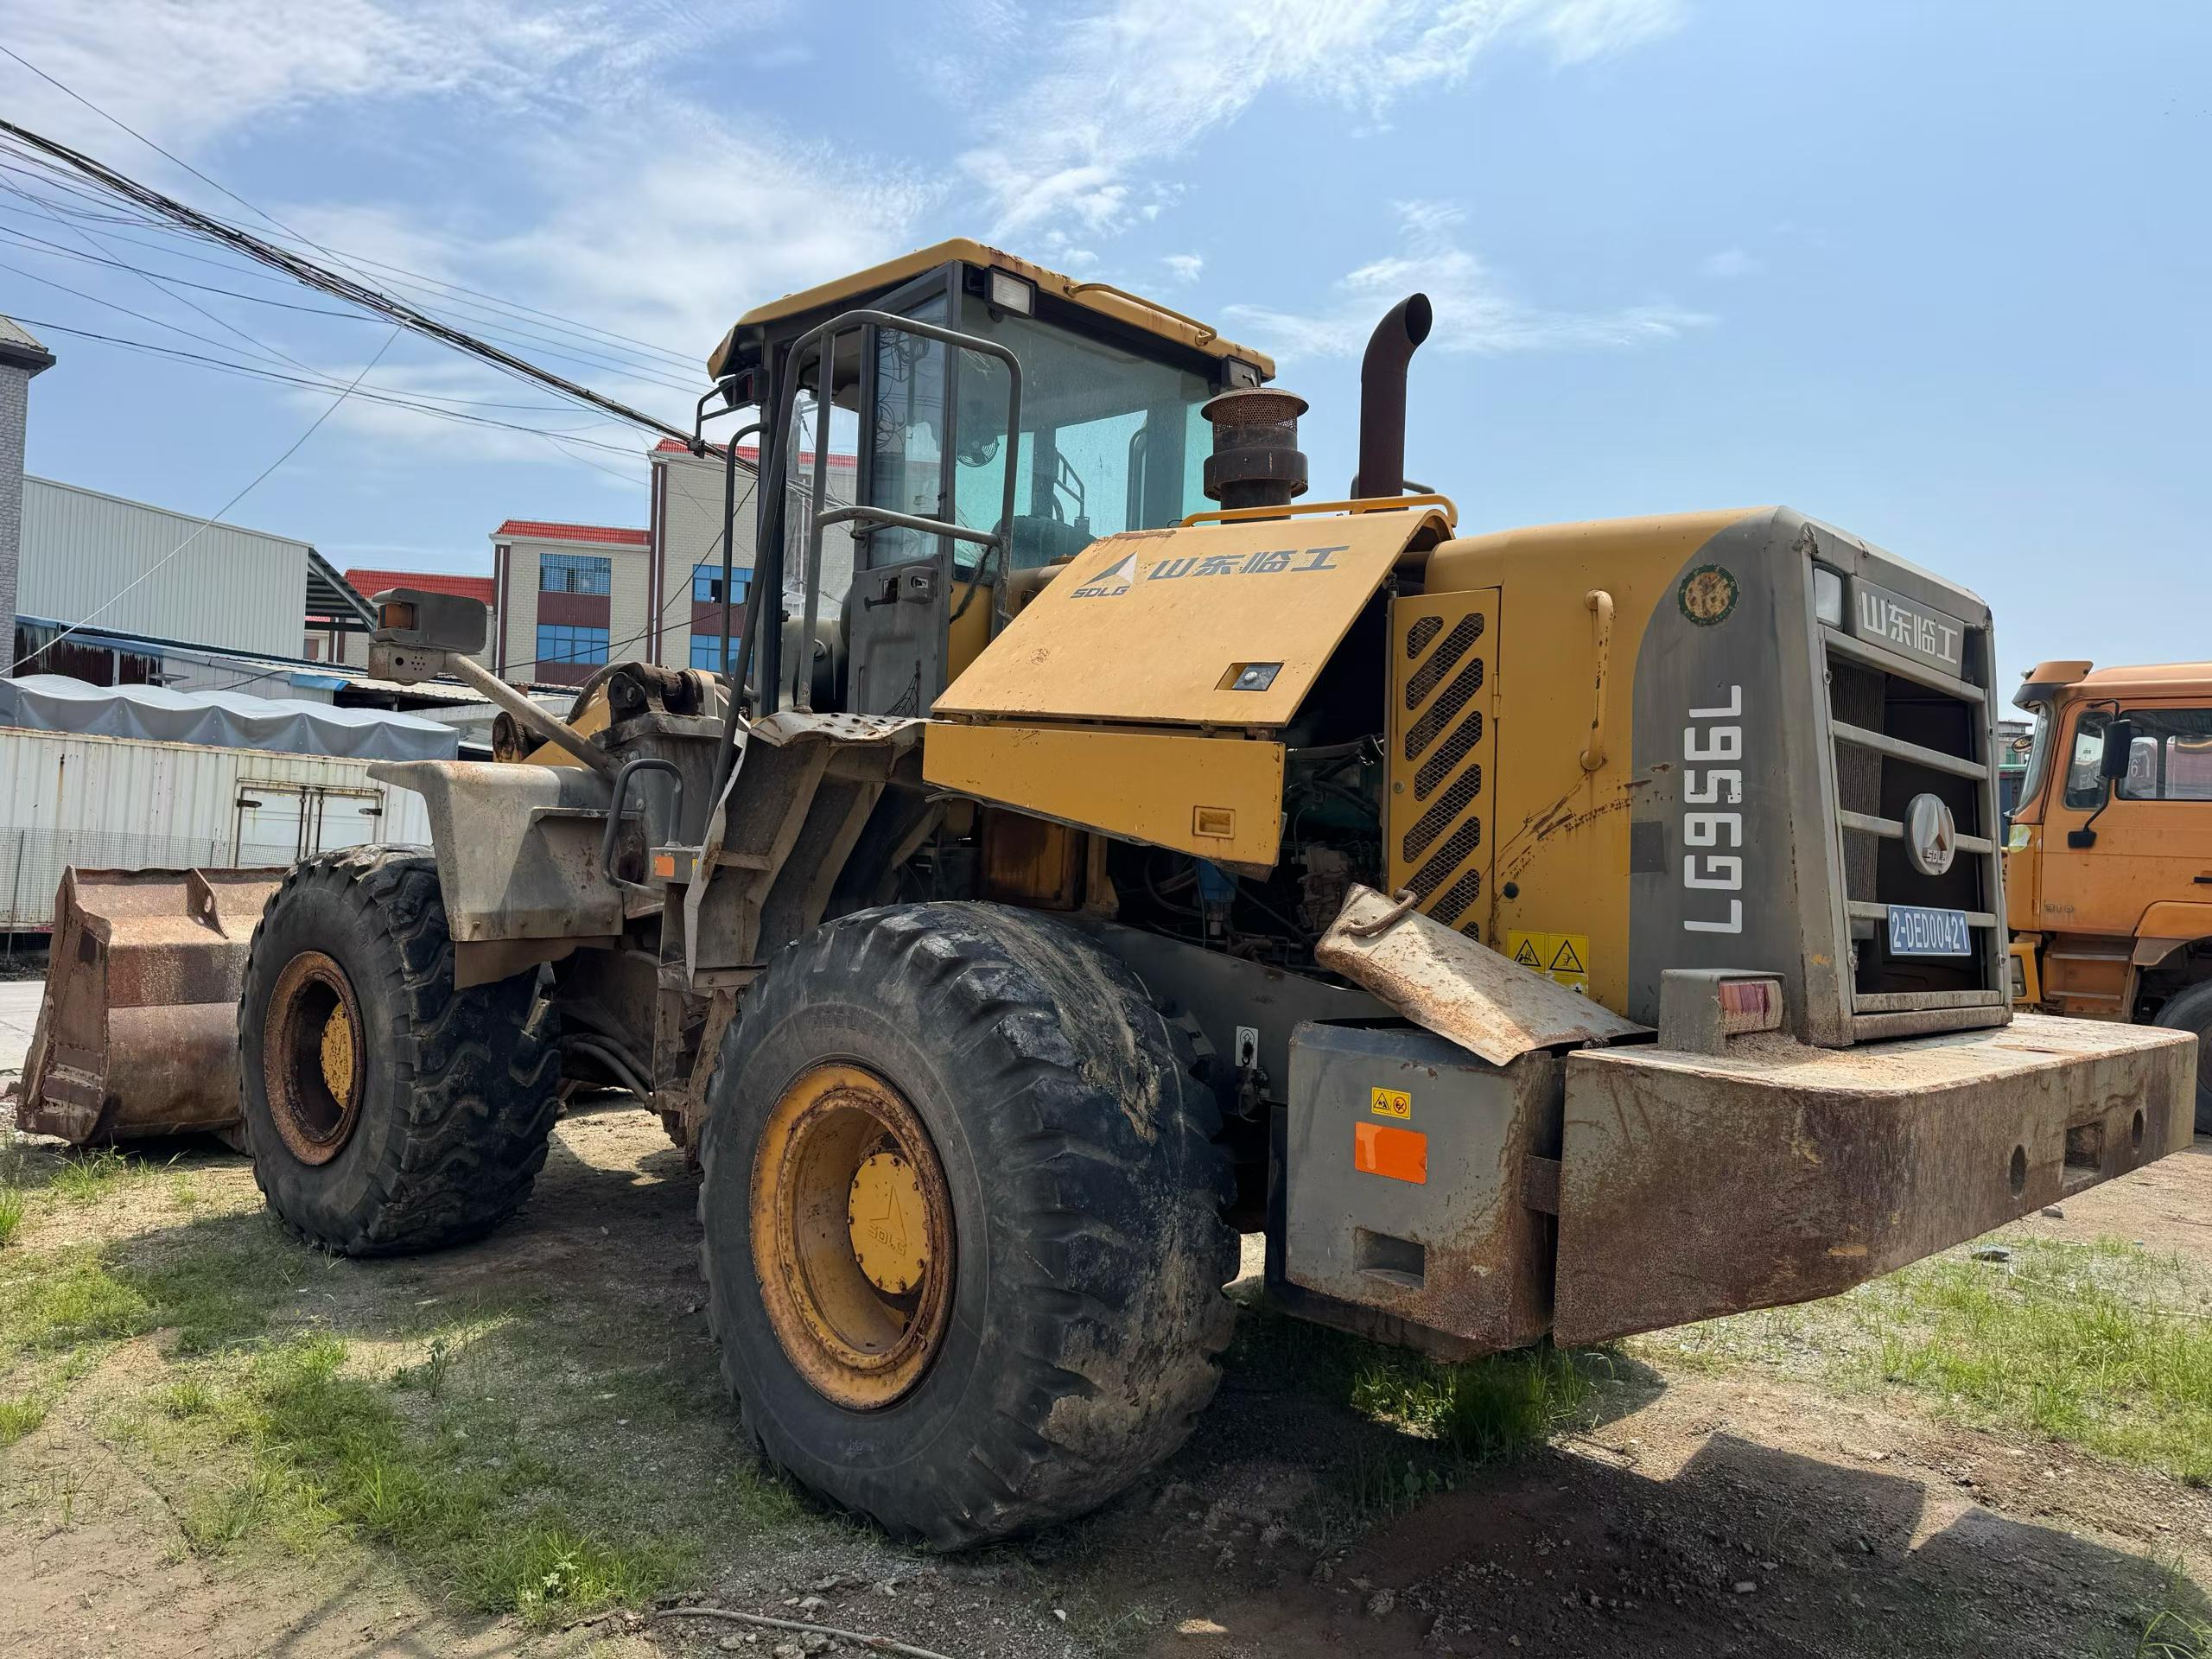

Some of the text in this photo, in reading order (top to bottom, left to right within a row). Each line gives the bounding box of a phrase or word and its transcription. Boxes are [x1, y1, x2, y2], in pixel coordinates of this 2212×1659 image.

[1147, 545, 1350, 581] 山东临工
[1069, 586, 1130, 598] SDLG
[1861, 591, 1958, 664] 山东临工
[1683, 685, 1742, 934] LG956L
